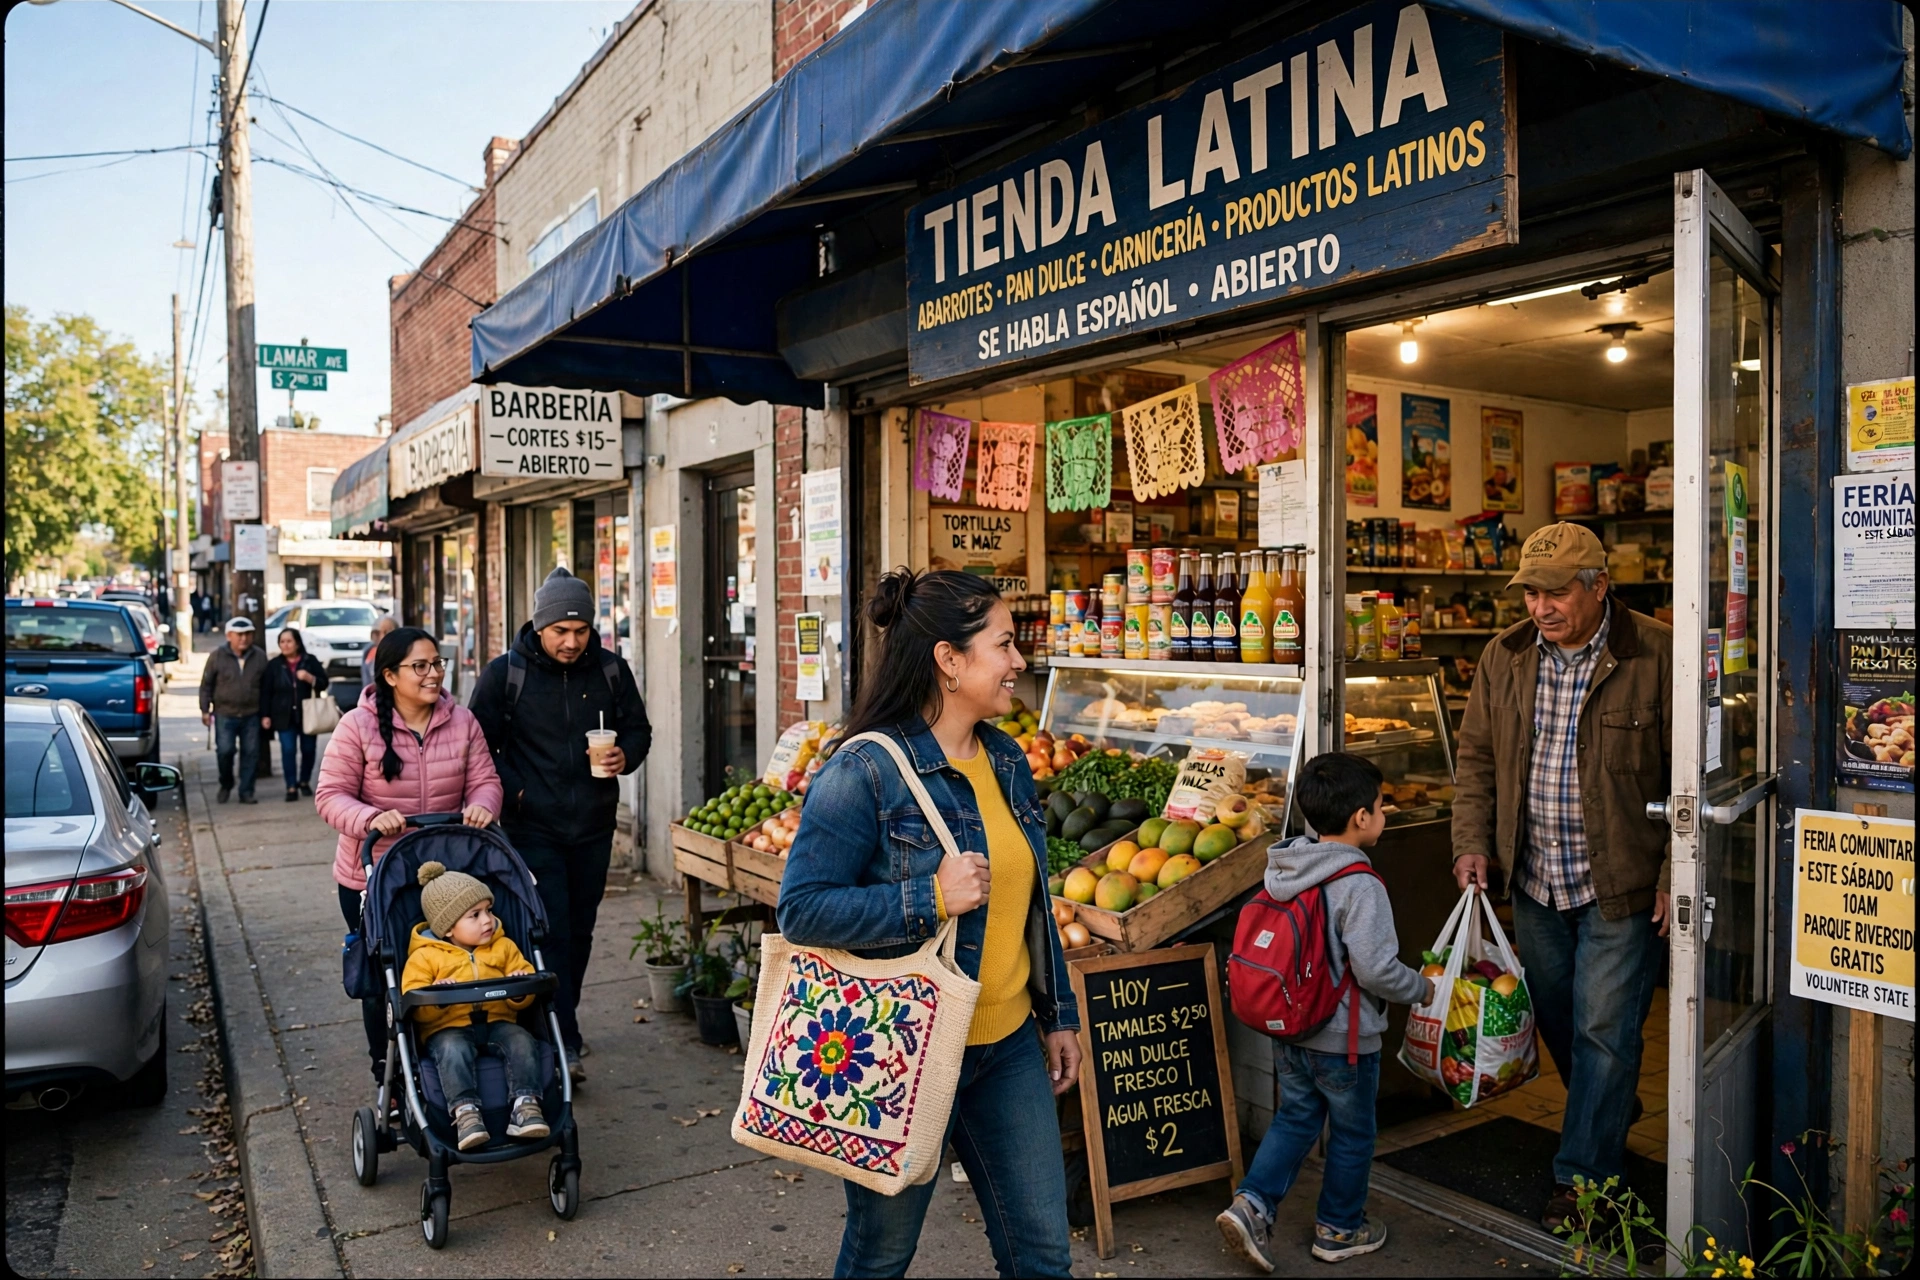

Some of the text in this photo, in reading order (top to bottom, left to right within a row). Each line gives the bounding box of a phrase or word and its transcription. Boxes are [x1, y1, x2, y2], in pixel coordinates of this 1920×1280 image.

[924, 4, 1449, 284] TIENDA LATINA
[917, 120, 1486, 332] ABARROTES PAN DULCE CARNICERÍA PRODUCTOS LATINOS
[978, 233, 1341, 360] SE HABLA ESPAÑOL ABIERTO
[263, 347, 343, 369] LAMAR AVE
[275, 372, 283, 387] S
[312, 375, 324, 387] ST
[507, 427, 605, 450] CORTES $15
[519, 454, 590, 475] ABIERTO
[942, 514, 1011, 532] TORTILLAS
[1864, 527, 1915, 539] ESTE SÁBAD
[952, 532, 1002, 550] DE MAÍZ
[1850, 645, 1875, 658] PAN
[1804, 829, 1915, 862] FERIA COMUNITAR
[1808, 861, 1893, 892] ESTE SÁBADO
[1843, 893, 1878, 917] 10AM
[1804, 913, 1915, 952] PARQUE RIVERSID
[1831, 946, 1884, 975] GRATIS
[1110, 978, 1150, 1009] HOY
[1806, 972, 1909, 1008] VOLUNTEER STATE
[1095, 1013, 1167, 1043] TAMALES
[1102, 1039, 1190, 1072] PAN DULCE
[1113, 1066, 1178, 1095] FRESCO
[1107, 1088, 1212, 1128] AGUA FRESCA
[1146, 1122, 1184, 1157] $2
